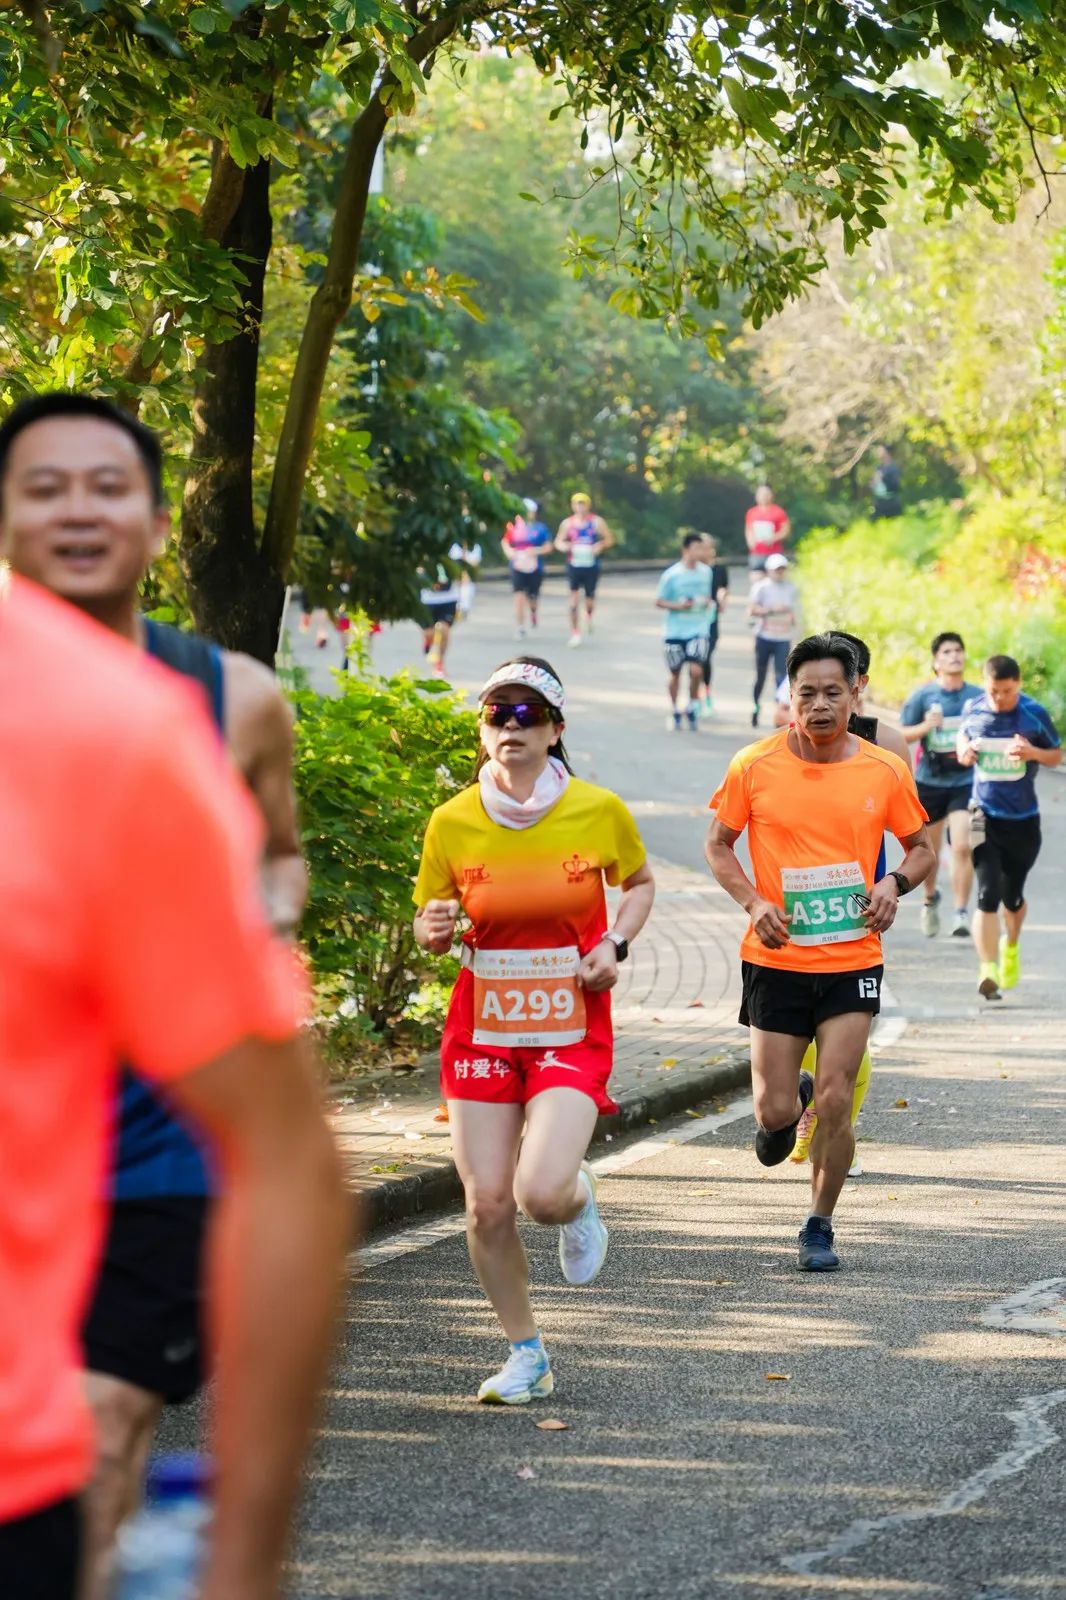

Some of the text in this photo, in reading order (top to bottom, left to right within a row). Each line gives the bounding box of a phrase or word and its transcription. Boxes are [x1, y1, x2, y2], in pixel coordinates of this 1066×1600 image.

[791, 896, 862, 926] A350
[481, 989, 575, 1022] A299
[454, 1058, 510, 1079] 付爱华
